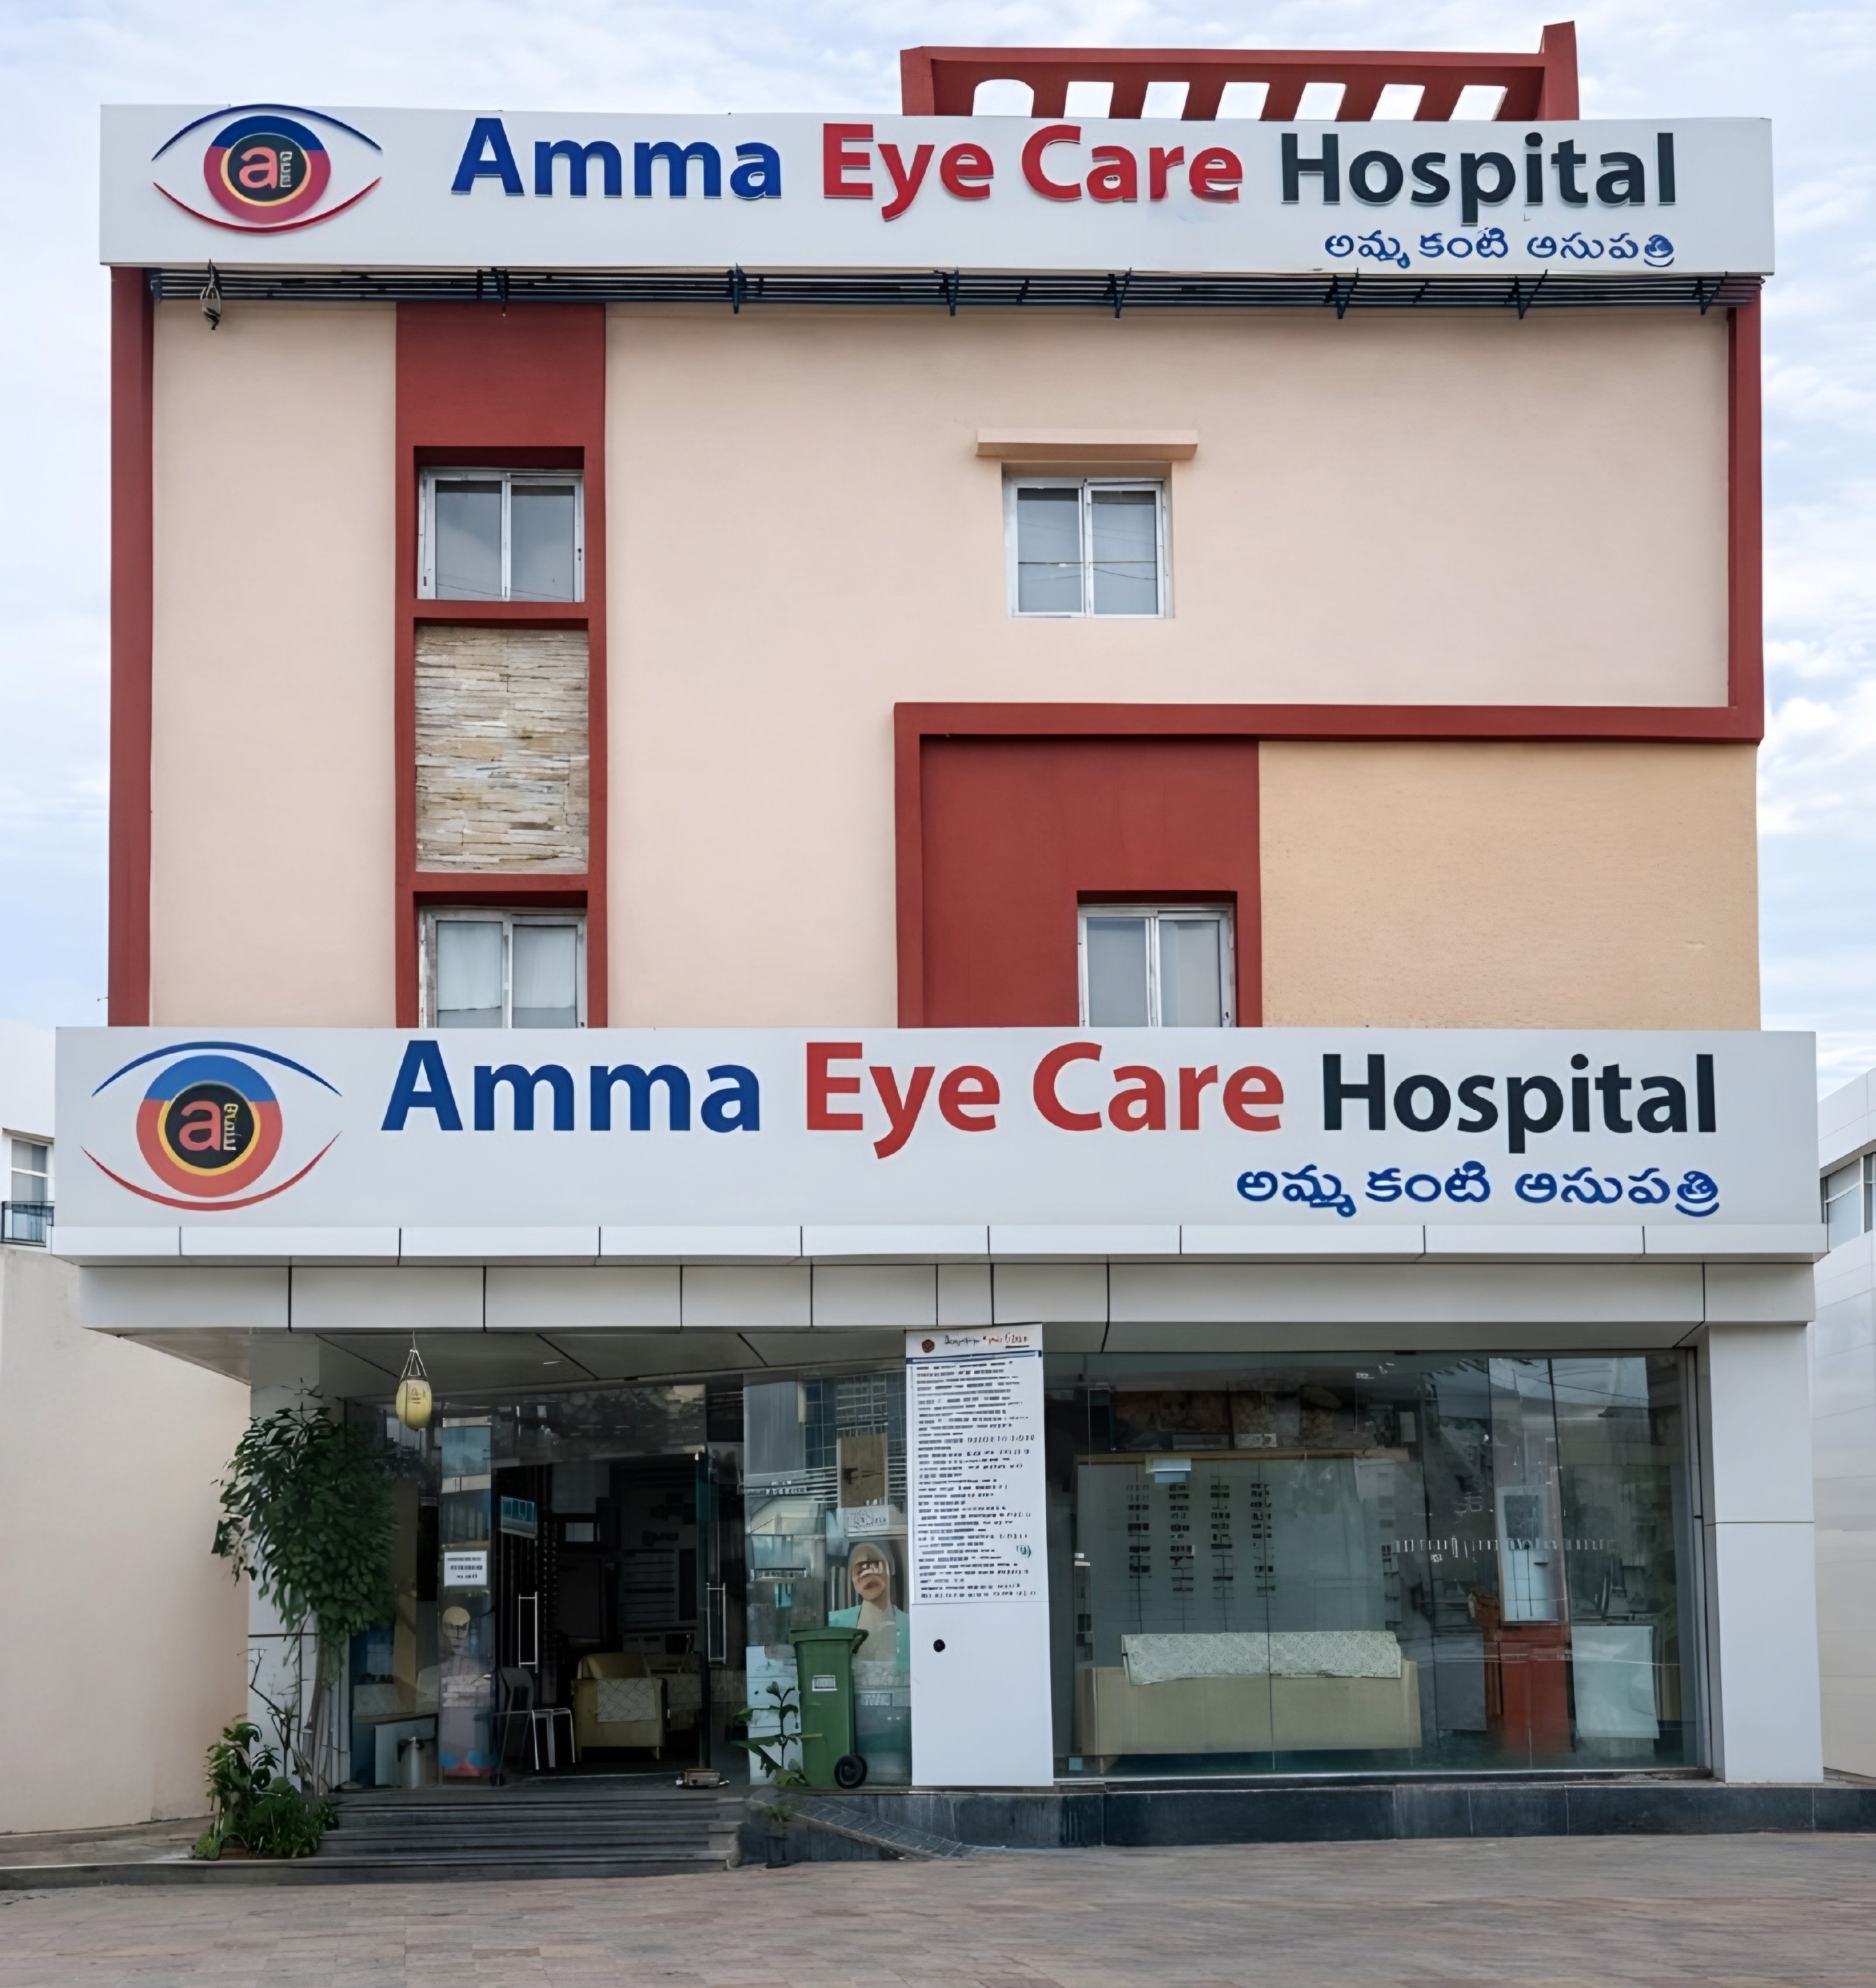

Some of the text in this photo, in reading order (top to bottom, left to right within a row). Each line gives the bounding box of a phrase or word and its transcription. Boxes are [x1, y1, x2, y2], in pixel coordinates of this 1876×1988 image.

[451, 118, 1676, 227] Amma Eye Care Hospital
[1325, 230, 1411, 269] అమ్మ
[1418, 227, 1508, 258] కంటి
[381, 1040, 1717, 1159] Amma Eye Care Hospital
[1237, 1161, 1720, 1218] అమ్మ కంటి ఆసుపత్రి
